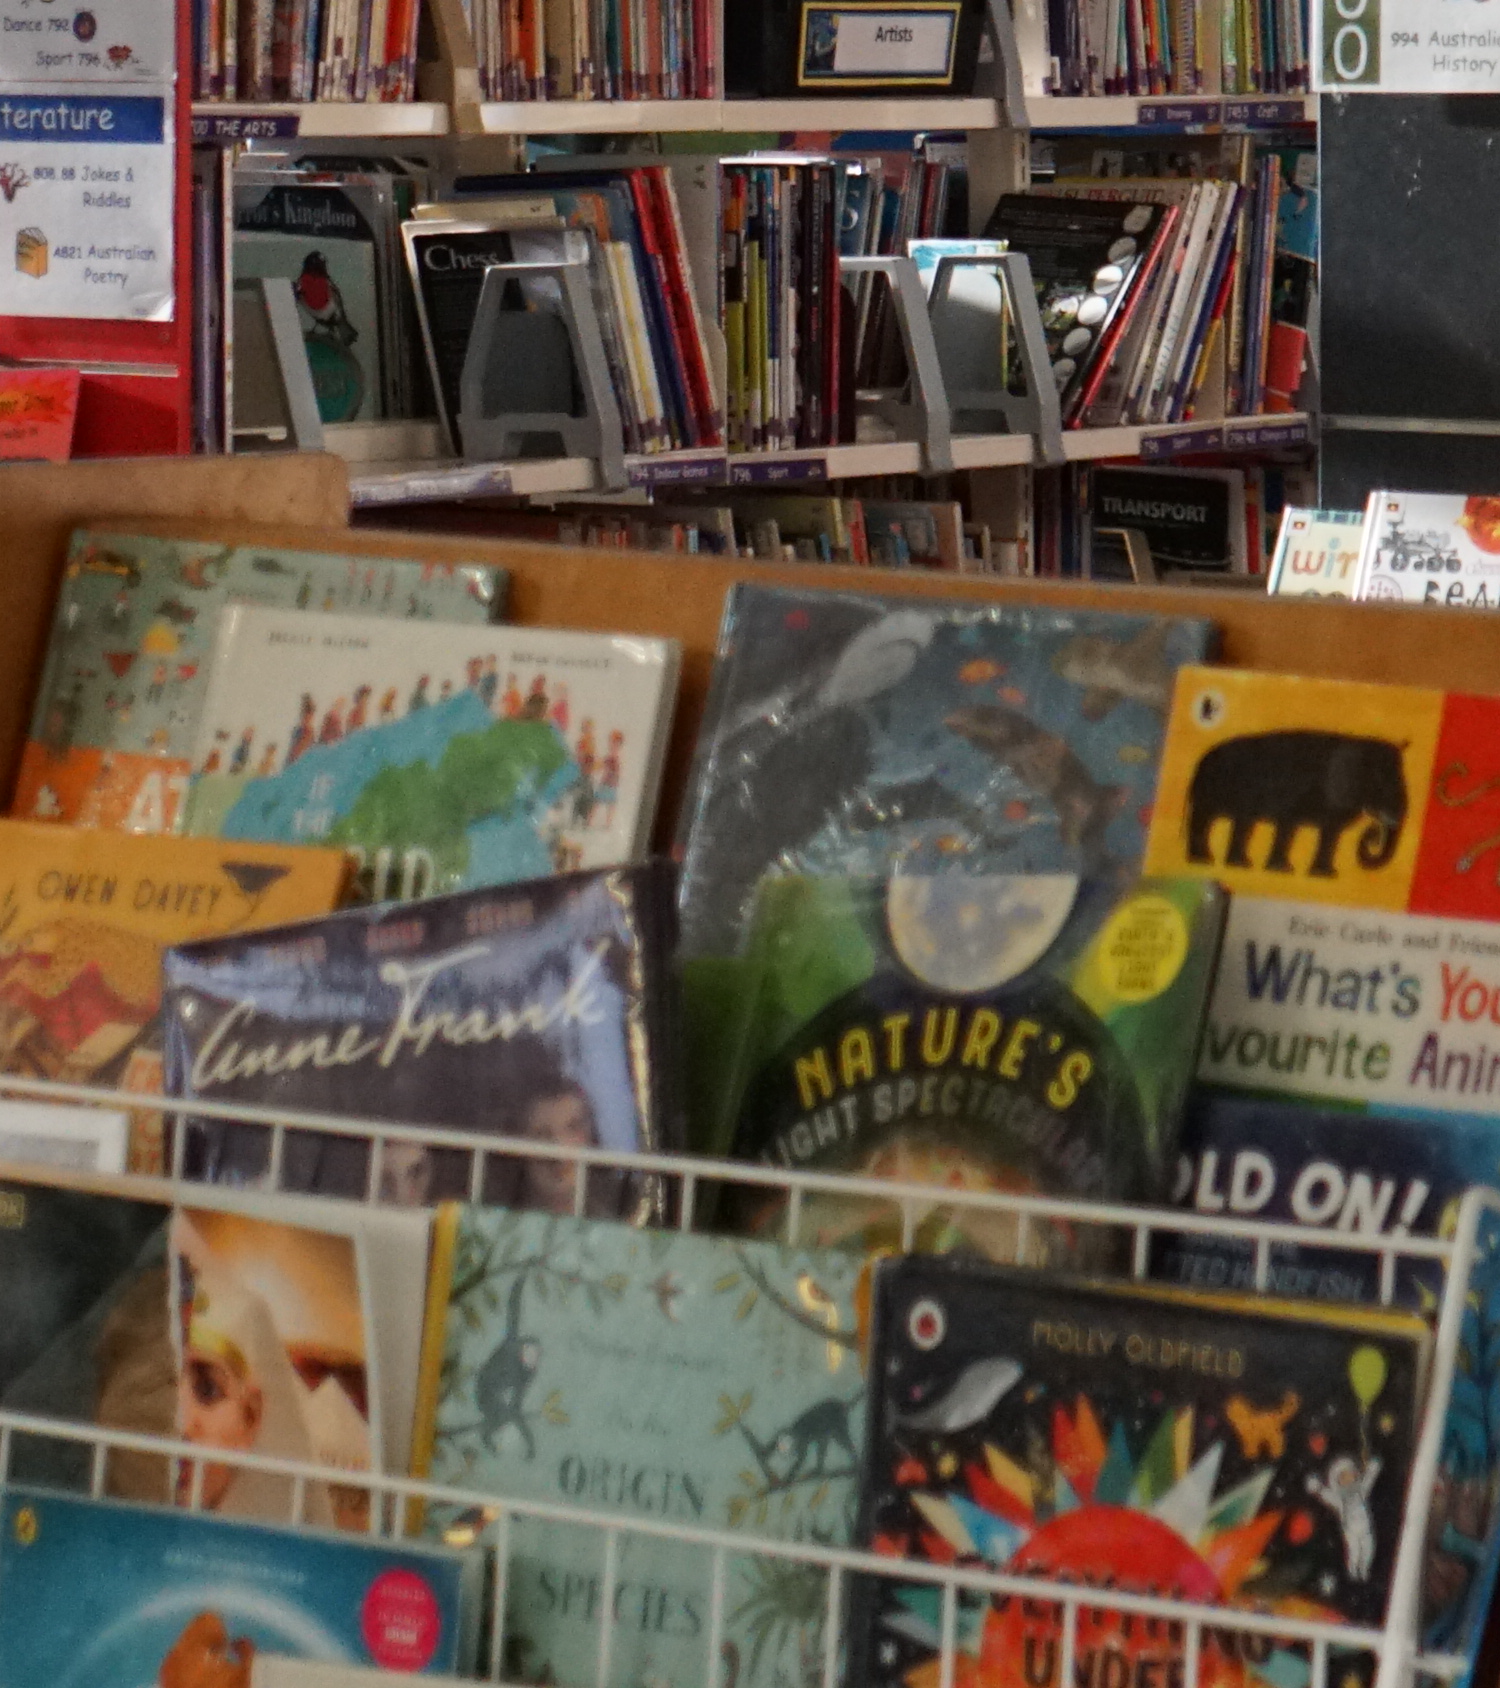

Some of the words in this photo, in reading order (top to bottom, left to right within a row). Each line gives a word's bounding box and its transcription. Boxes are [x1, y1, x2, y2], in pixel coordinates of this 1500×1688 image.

[3, 17, 43, 32] Dance
[875, 25, 914, 43] Artists
[1390, 31, 1419, 48] 994
[35, 51, 74, 69] Sport
[1432, 54, 1498, 77] History
[215, 120, 240, 137] THE
[242, 120, 278, 138] ARTS
[81, 165, 120, 183] Jokes
[82, 191, 132, 209] Riddles
[284, 193, 357, 233] Kingdom
[88, 245, 157, 260] Australian
[424, 243, 500, 271] Chess
[83, 266, 130, 289] Poetry
[1102, 496, 1208, 524] TRANSPORT
[37, 870, 118, 906] OWEN
[133, 878, 222, 916] DAVEY
[1288, 915, 1330, 939] Eric
[1338, 918, 1393, 947] Carle
[1402, 926, 1440, 951] and
[1244, 939, 1423, 1019] What's
[191, 997, 382, 1090] Anne
[379, 937, 612, 1069] Frank
[794, 1007, 1095, 1111] NATURE'S
[1032, 1320, 1117, 1355] MOLLY
[1125, 1334, 1243, 1379] OLDFIELD
[558, 1456, 705, 1515] ORIGIN
